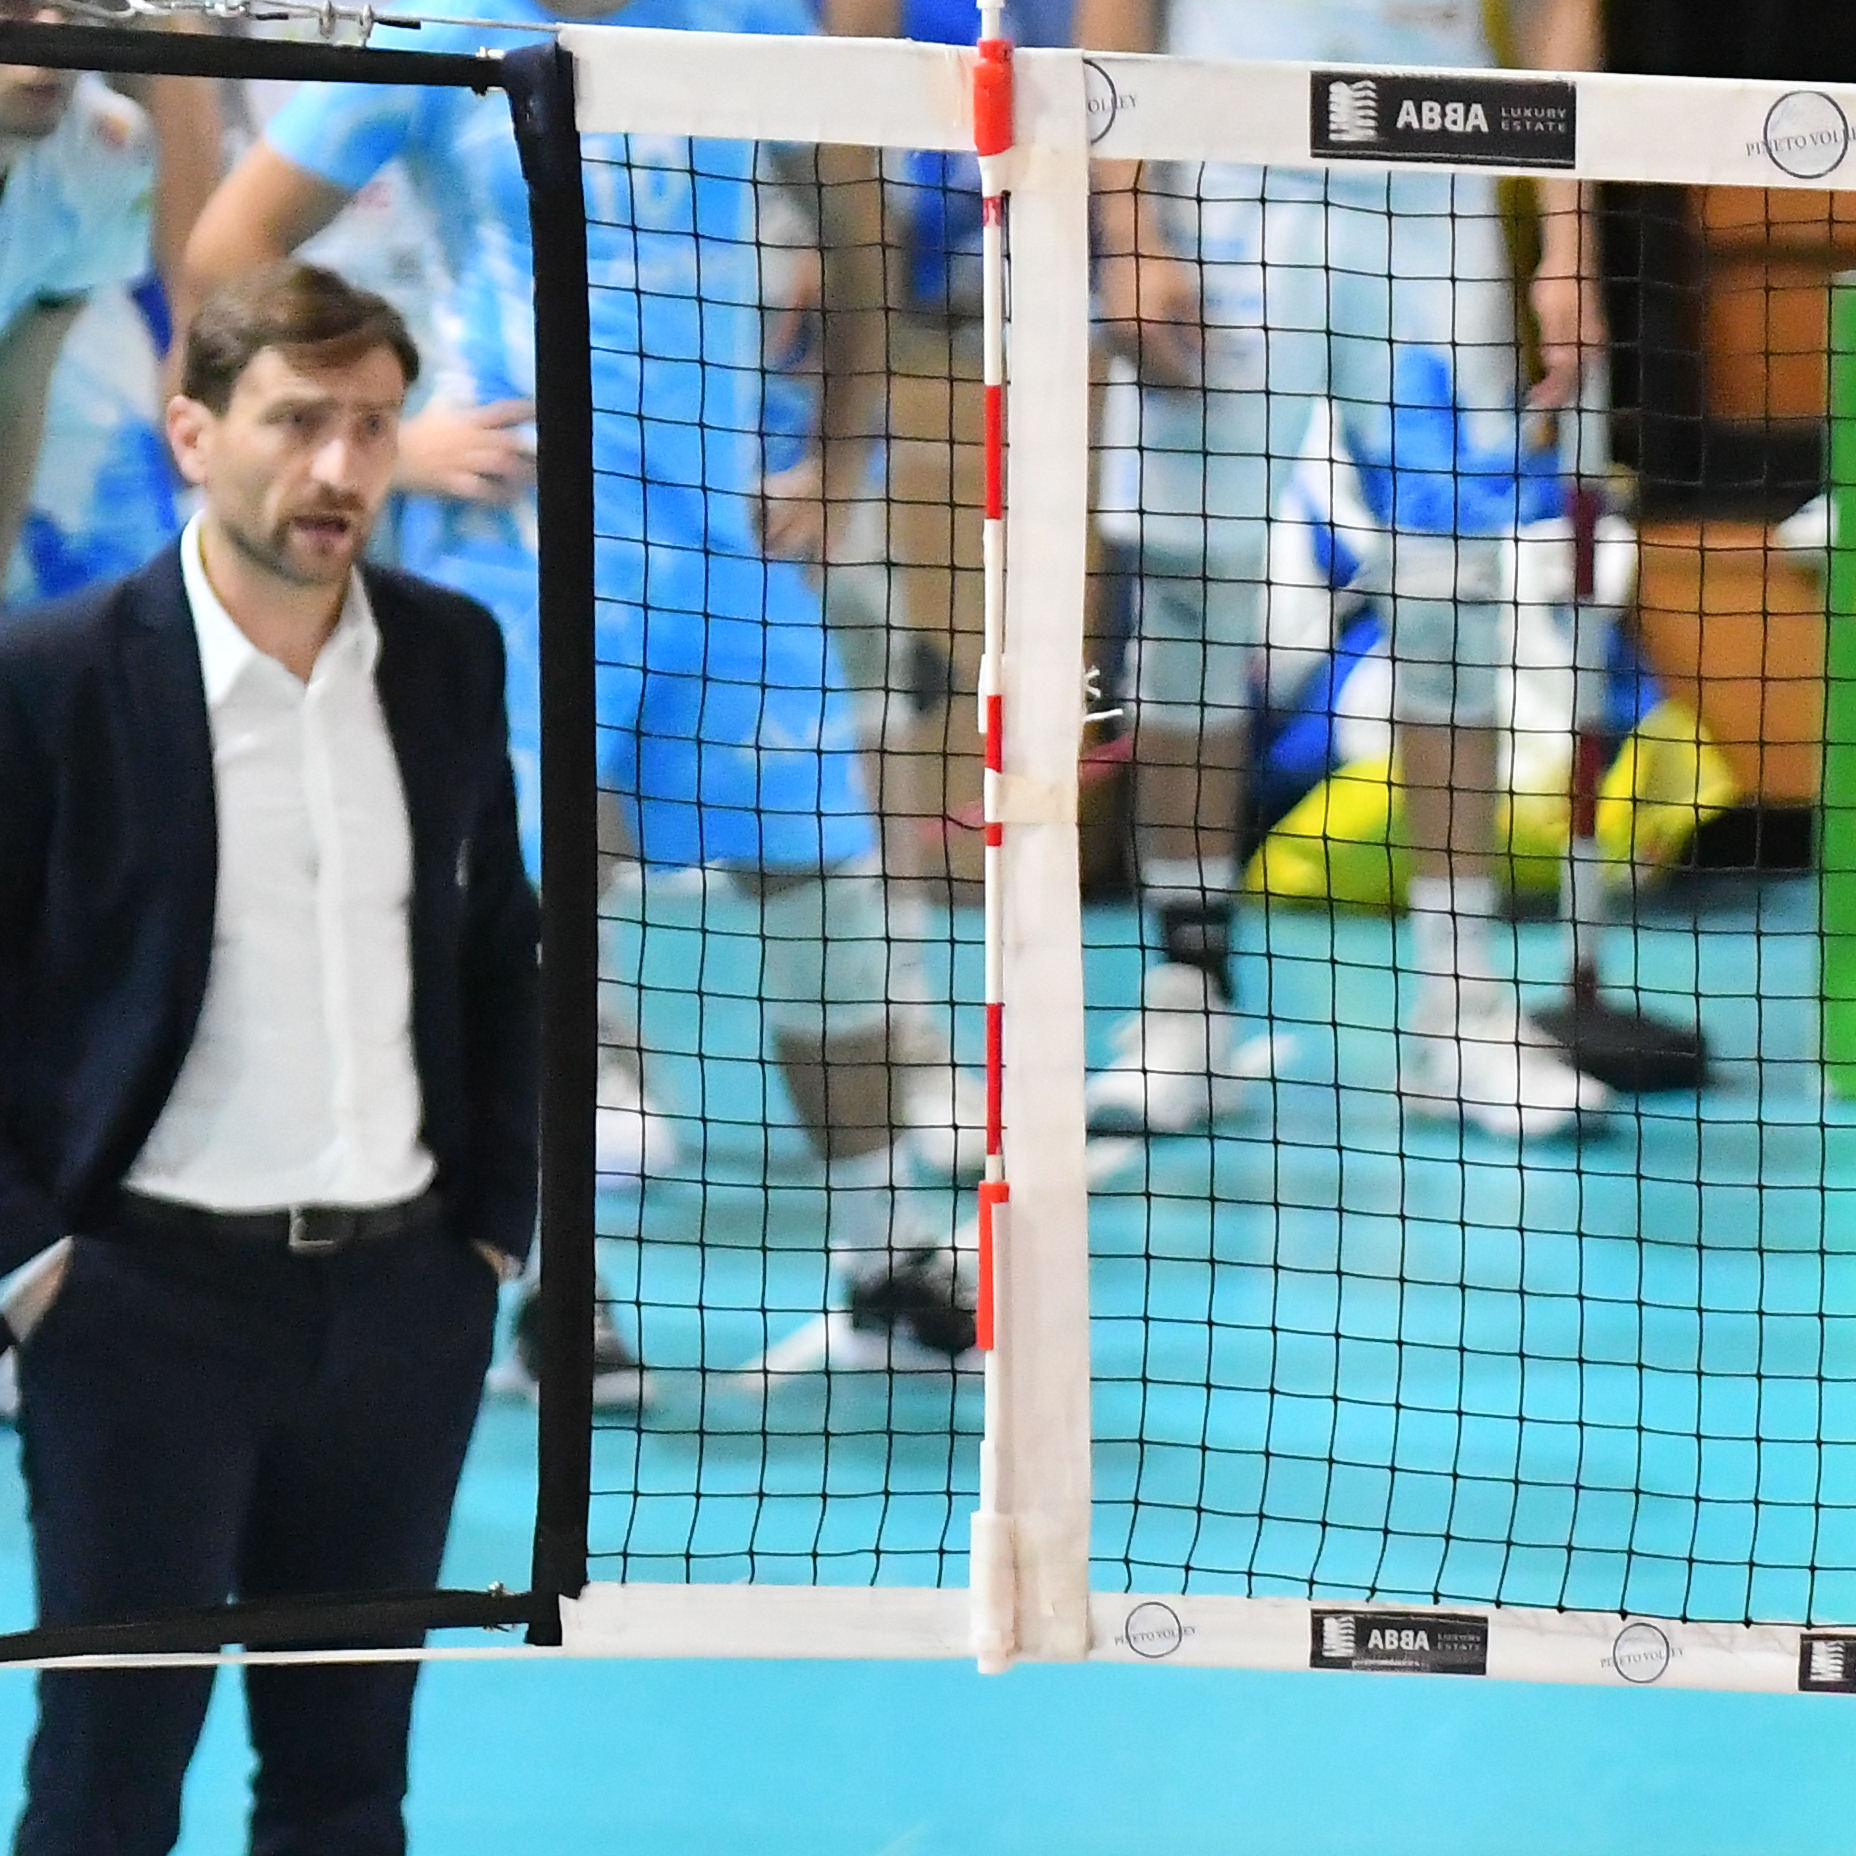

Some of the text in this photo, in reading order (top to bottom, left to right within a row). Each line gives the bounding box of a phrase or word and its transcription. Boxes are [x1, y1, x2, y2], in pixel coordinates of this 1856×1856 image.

[1087, 93, 1138, 114] OLLEY
[1395, 99, 1489, 134] ABBA
[1367, 1628, 1430, 1651] ABBA
